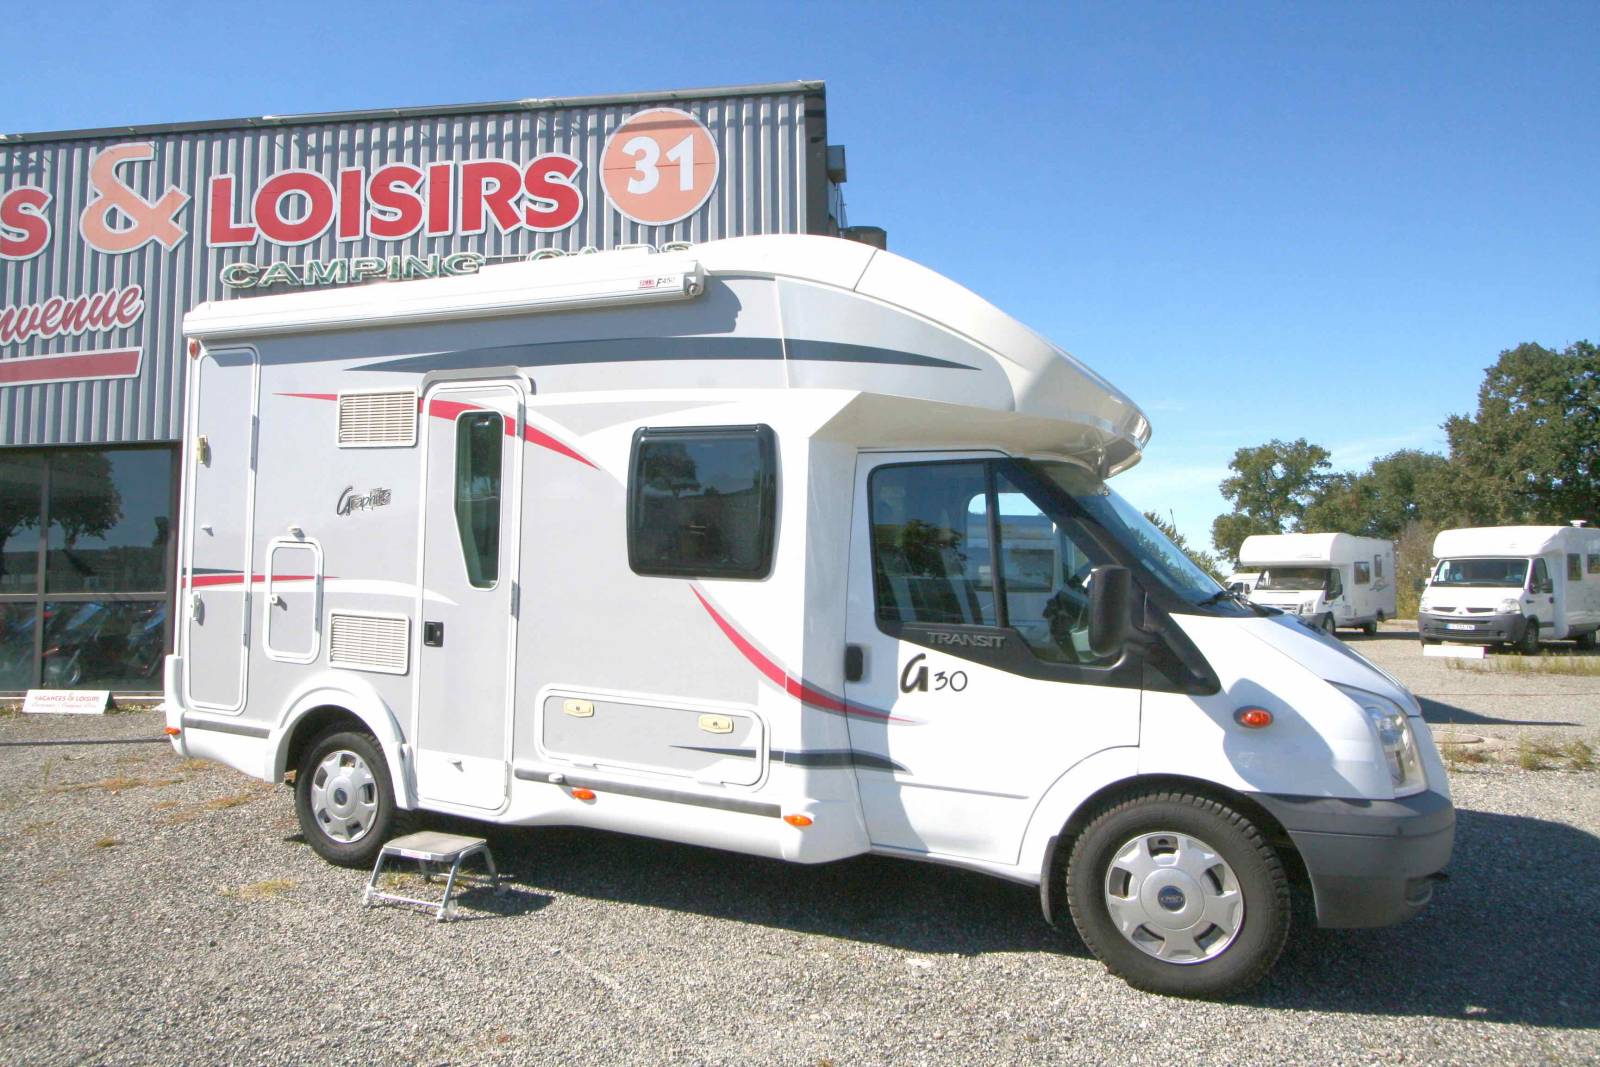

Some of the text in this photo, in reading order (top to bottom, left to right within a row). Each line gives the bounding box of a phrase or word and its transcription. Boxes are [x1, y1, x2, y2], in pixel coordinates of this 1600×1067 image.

[80, 142, 191, 254] &
[207, 152, 583, 248] LOISIRS
[622, 134, 694, 196] 31
[220, 252, 486, 288] CAMPING
[927, 632, 1006, 648] TRANSIT
